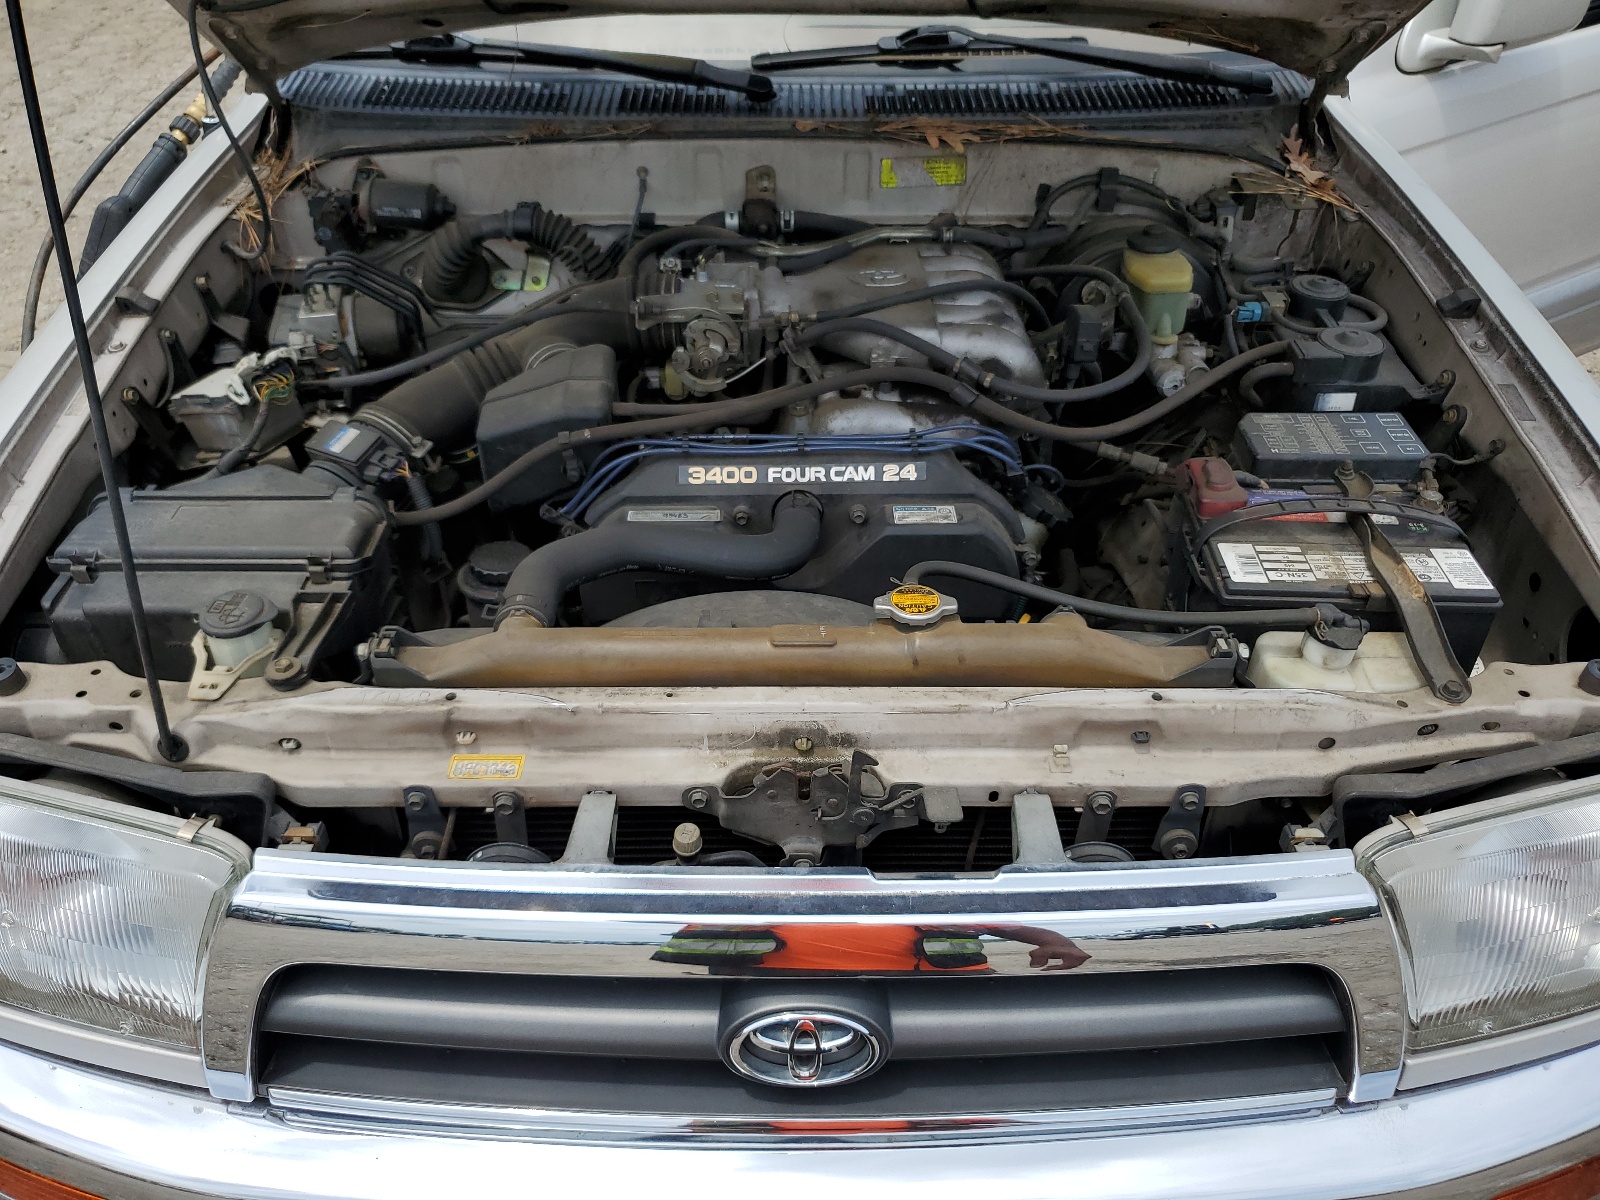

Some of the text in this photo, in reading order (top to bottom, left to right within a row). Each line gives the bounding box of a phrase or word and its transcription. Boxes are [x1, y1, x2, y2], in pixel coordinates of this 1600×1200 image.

[688, 463, 918, 484] 3400 FOUR CAM 24
